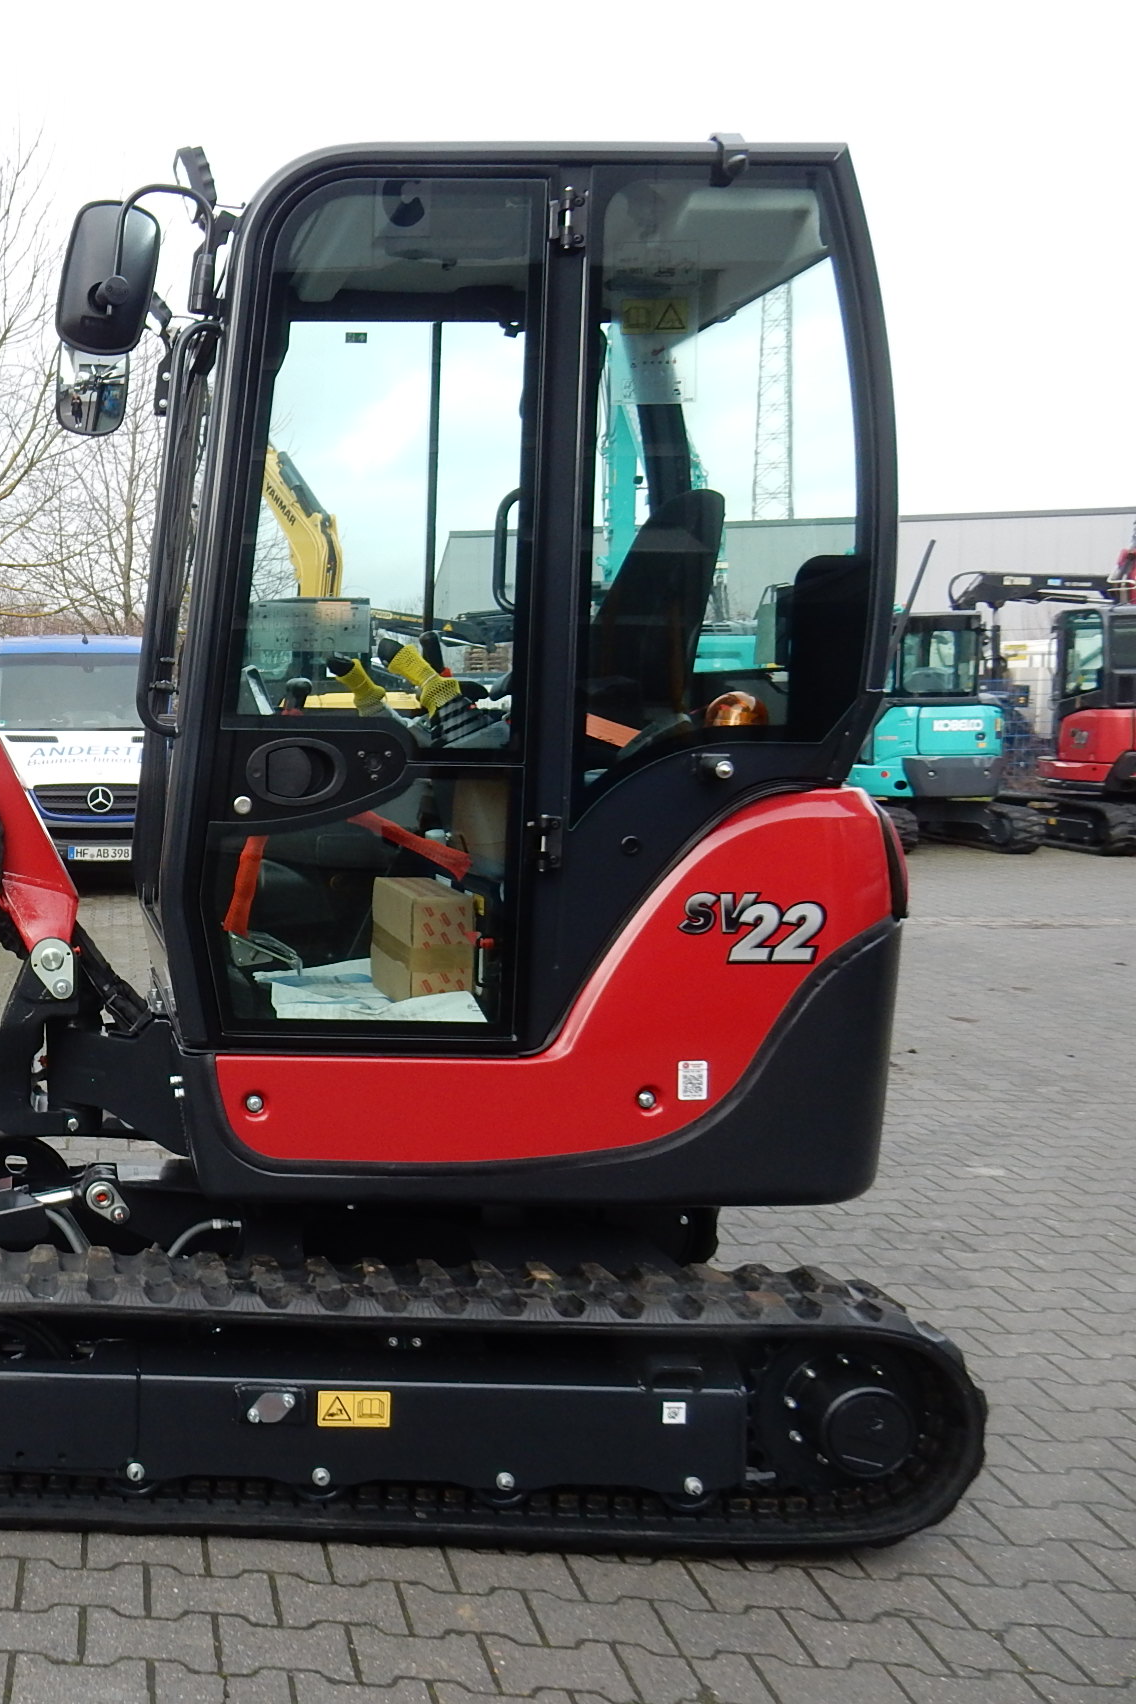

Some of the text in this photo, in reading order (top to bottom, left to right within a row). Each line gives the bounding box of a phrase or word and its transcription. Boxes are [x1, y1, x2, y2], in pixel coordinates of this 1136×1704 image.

[265, 482, 297, 527] YANMAR
[29, 745, 137, 758] ANDERT
[75, 848, 130, 859] HF AB 398
[677, 891, 828, 965] SV22
